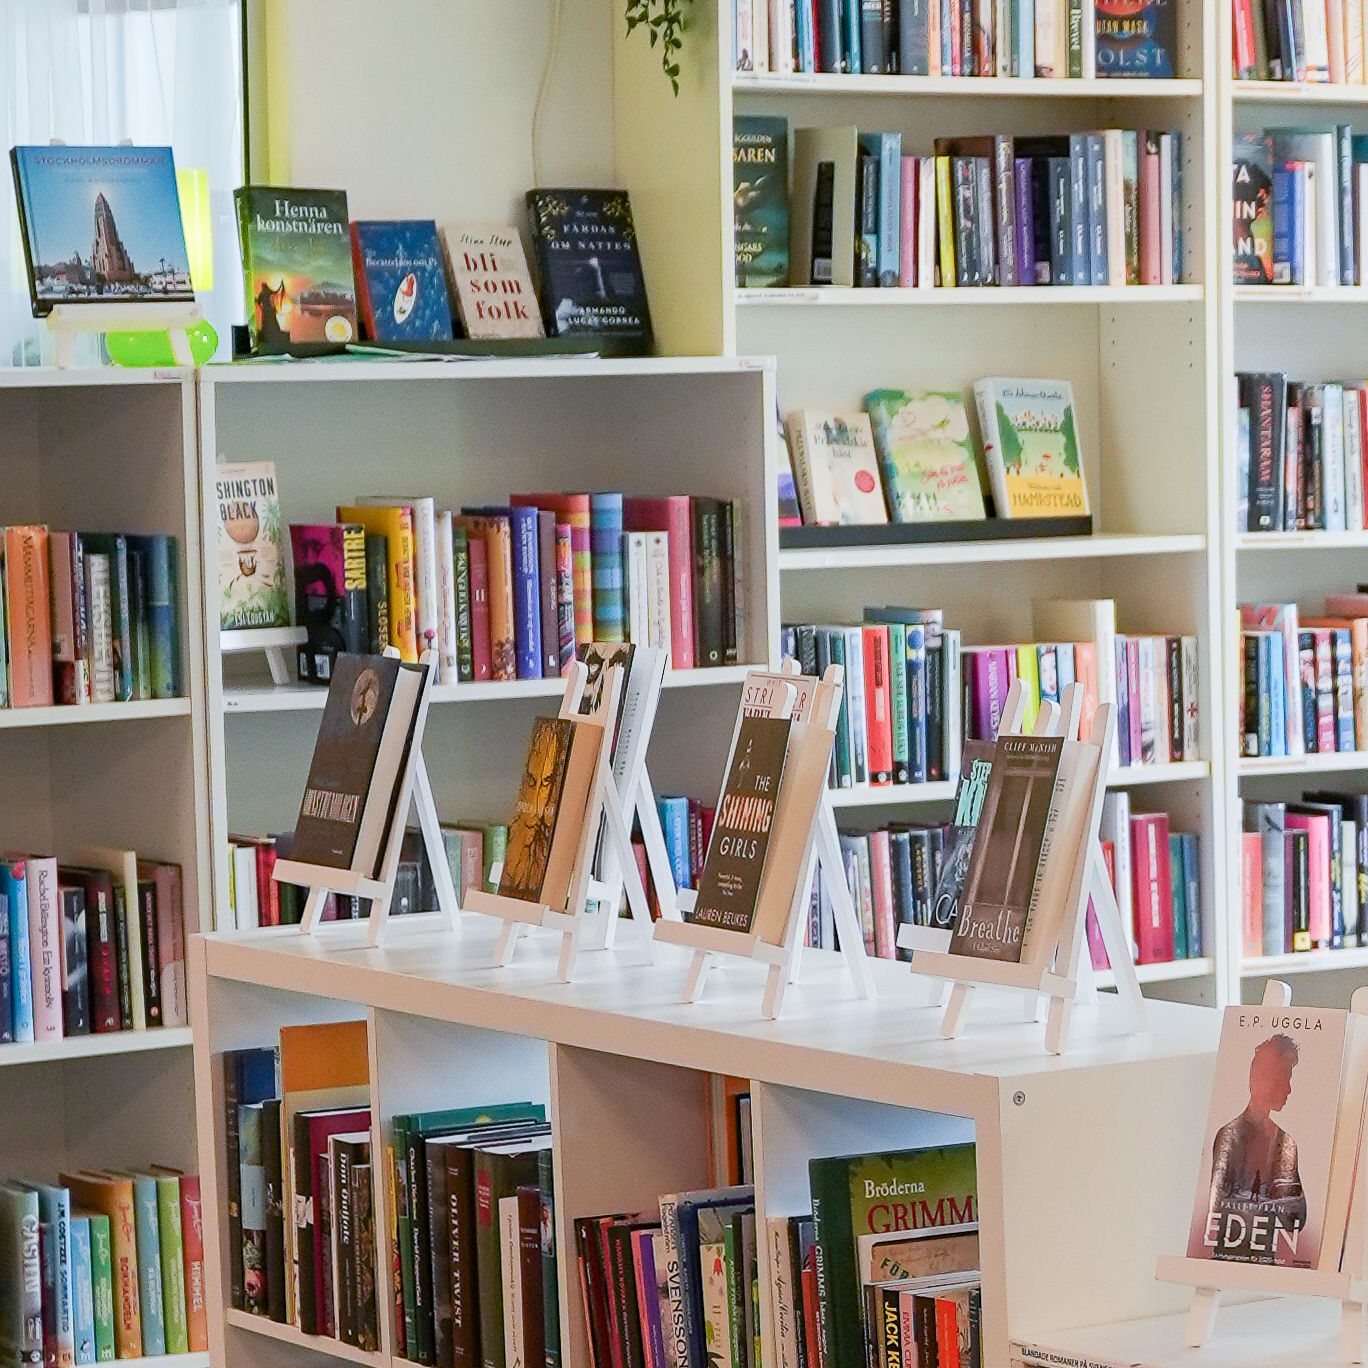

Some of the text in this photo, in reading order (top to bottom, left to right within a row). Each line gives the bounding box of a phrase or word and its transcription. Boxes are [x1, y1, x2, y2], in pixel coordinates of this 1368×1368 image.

[274, 199, 327, 218] Henna
[256, 214, 343, 235] konstnären
[550, 240, 570, 250] OM
[464, 251, 498, 273] bli
[469, 279, 522, 295] som
[476, 300, 529, 321] folk
[220, 501, 259, 521] BLACK
[1004, 740, 1028, 753] CLIFF
[754, 774, 772, 792] THE
[719, 794, 774, 832] SHINING
[719, 836, 758, 859] GIRLS
[694, 905, 750, 928] LAUREN BEUKES
[957, 904, 1021, 946] Breathe
[1240, 1015, 1322, 1031] E.P. UGGLA
[864, 1178, 925, 1199] Bröderna
[1204, 1212, 1299, 1255] EDEN
[449, 1193, 463, 1328] OLIVER TWIST
[884, 1301, 899, 1347] JACK
[902, 1311, 911, 1341] EMMA
